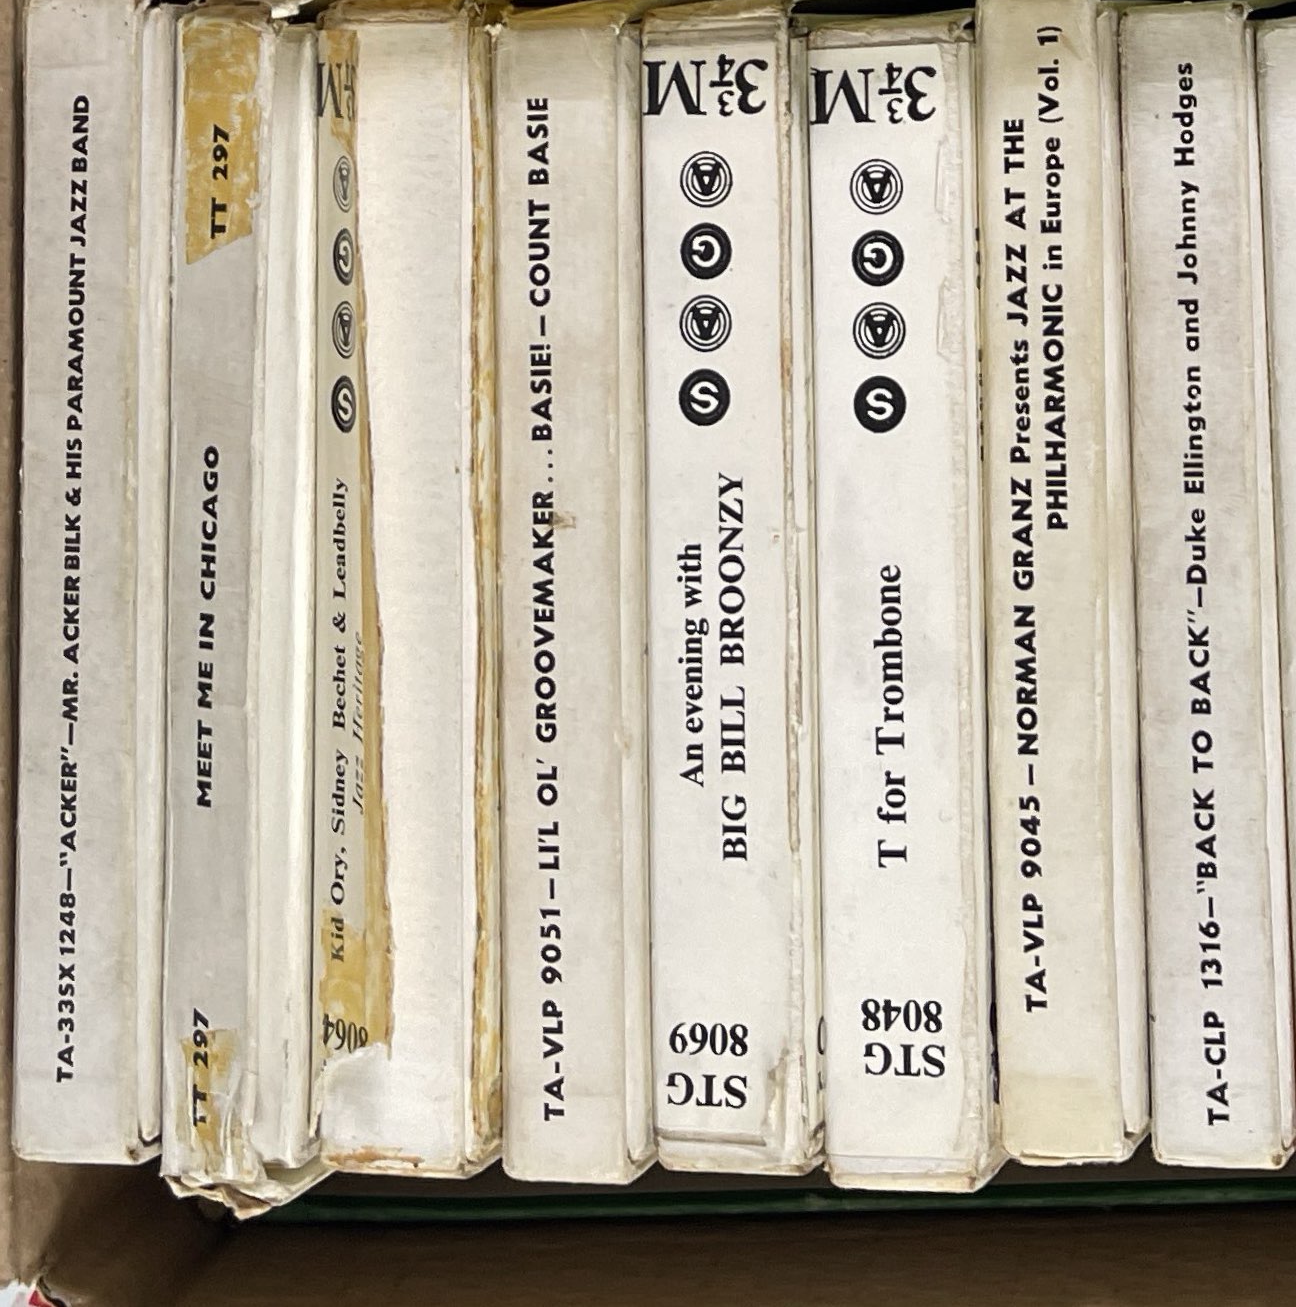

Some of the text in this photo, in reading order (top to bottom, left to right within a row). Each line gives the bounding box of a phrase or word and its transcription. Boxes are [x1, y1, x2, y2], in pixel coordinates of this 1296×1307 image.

[72, 96, 89, 172] BAND
[1172, 63, 1197, 166] Hodges
[70, 180, 87, 247] JAZZ
[211, 124, 230, 239] TT 297
[1175, 181, 1199, 284] Johnny
[1037, 27, 1068, 529] PHILHARMONIC in Europe (Vol. 1)
[1178, 299, 1199, 351] and
[67, 253, 85, 430] PARAMOUNT
[66, 438, 82, 479] HIS
[1183, 367, 1206, 493] Ellington
[64, 514, 80, 570] BILK
[65, 488, 81, 506] &
[63, 576, 80, 664] ACKER
[527, 98, 564, 1121] TA-VLP 9051 LI'L OL' GROOVEMAKER BASIE! COUNT BASIE
[1004, 119, 1047, 1012] TA-VLP 9045 NORMAN GRANZ Presents JAZZ AT THE
[197, 446, 218, 807] MEET ME IN CHICAGO
[677, 544, 709, 787] An evening with
[719, 473, 747, 860] BIG BILL BROONZY
[331, 478, 348, 962] Kid Ory, Sidney Bechet & Leadbelly
[351, 632, 365, 815] Jazz Heritage
[874, 566, 906, 868] T for Trombone
[1192, 731, 1213, 773] TO
[57, 964, 75, 1082] TA-33SX
[192, 1008, 209, 1127] TT 297
[670, 1023, 748, 1056] 8069
[862, 999, 942, 1033] 8048
[864, 1043, 945, 1077] STG
[1204, 1012, 1229, 1125] TA-CLP
[667, 1073, 747, 1109] STG
